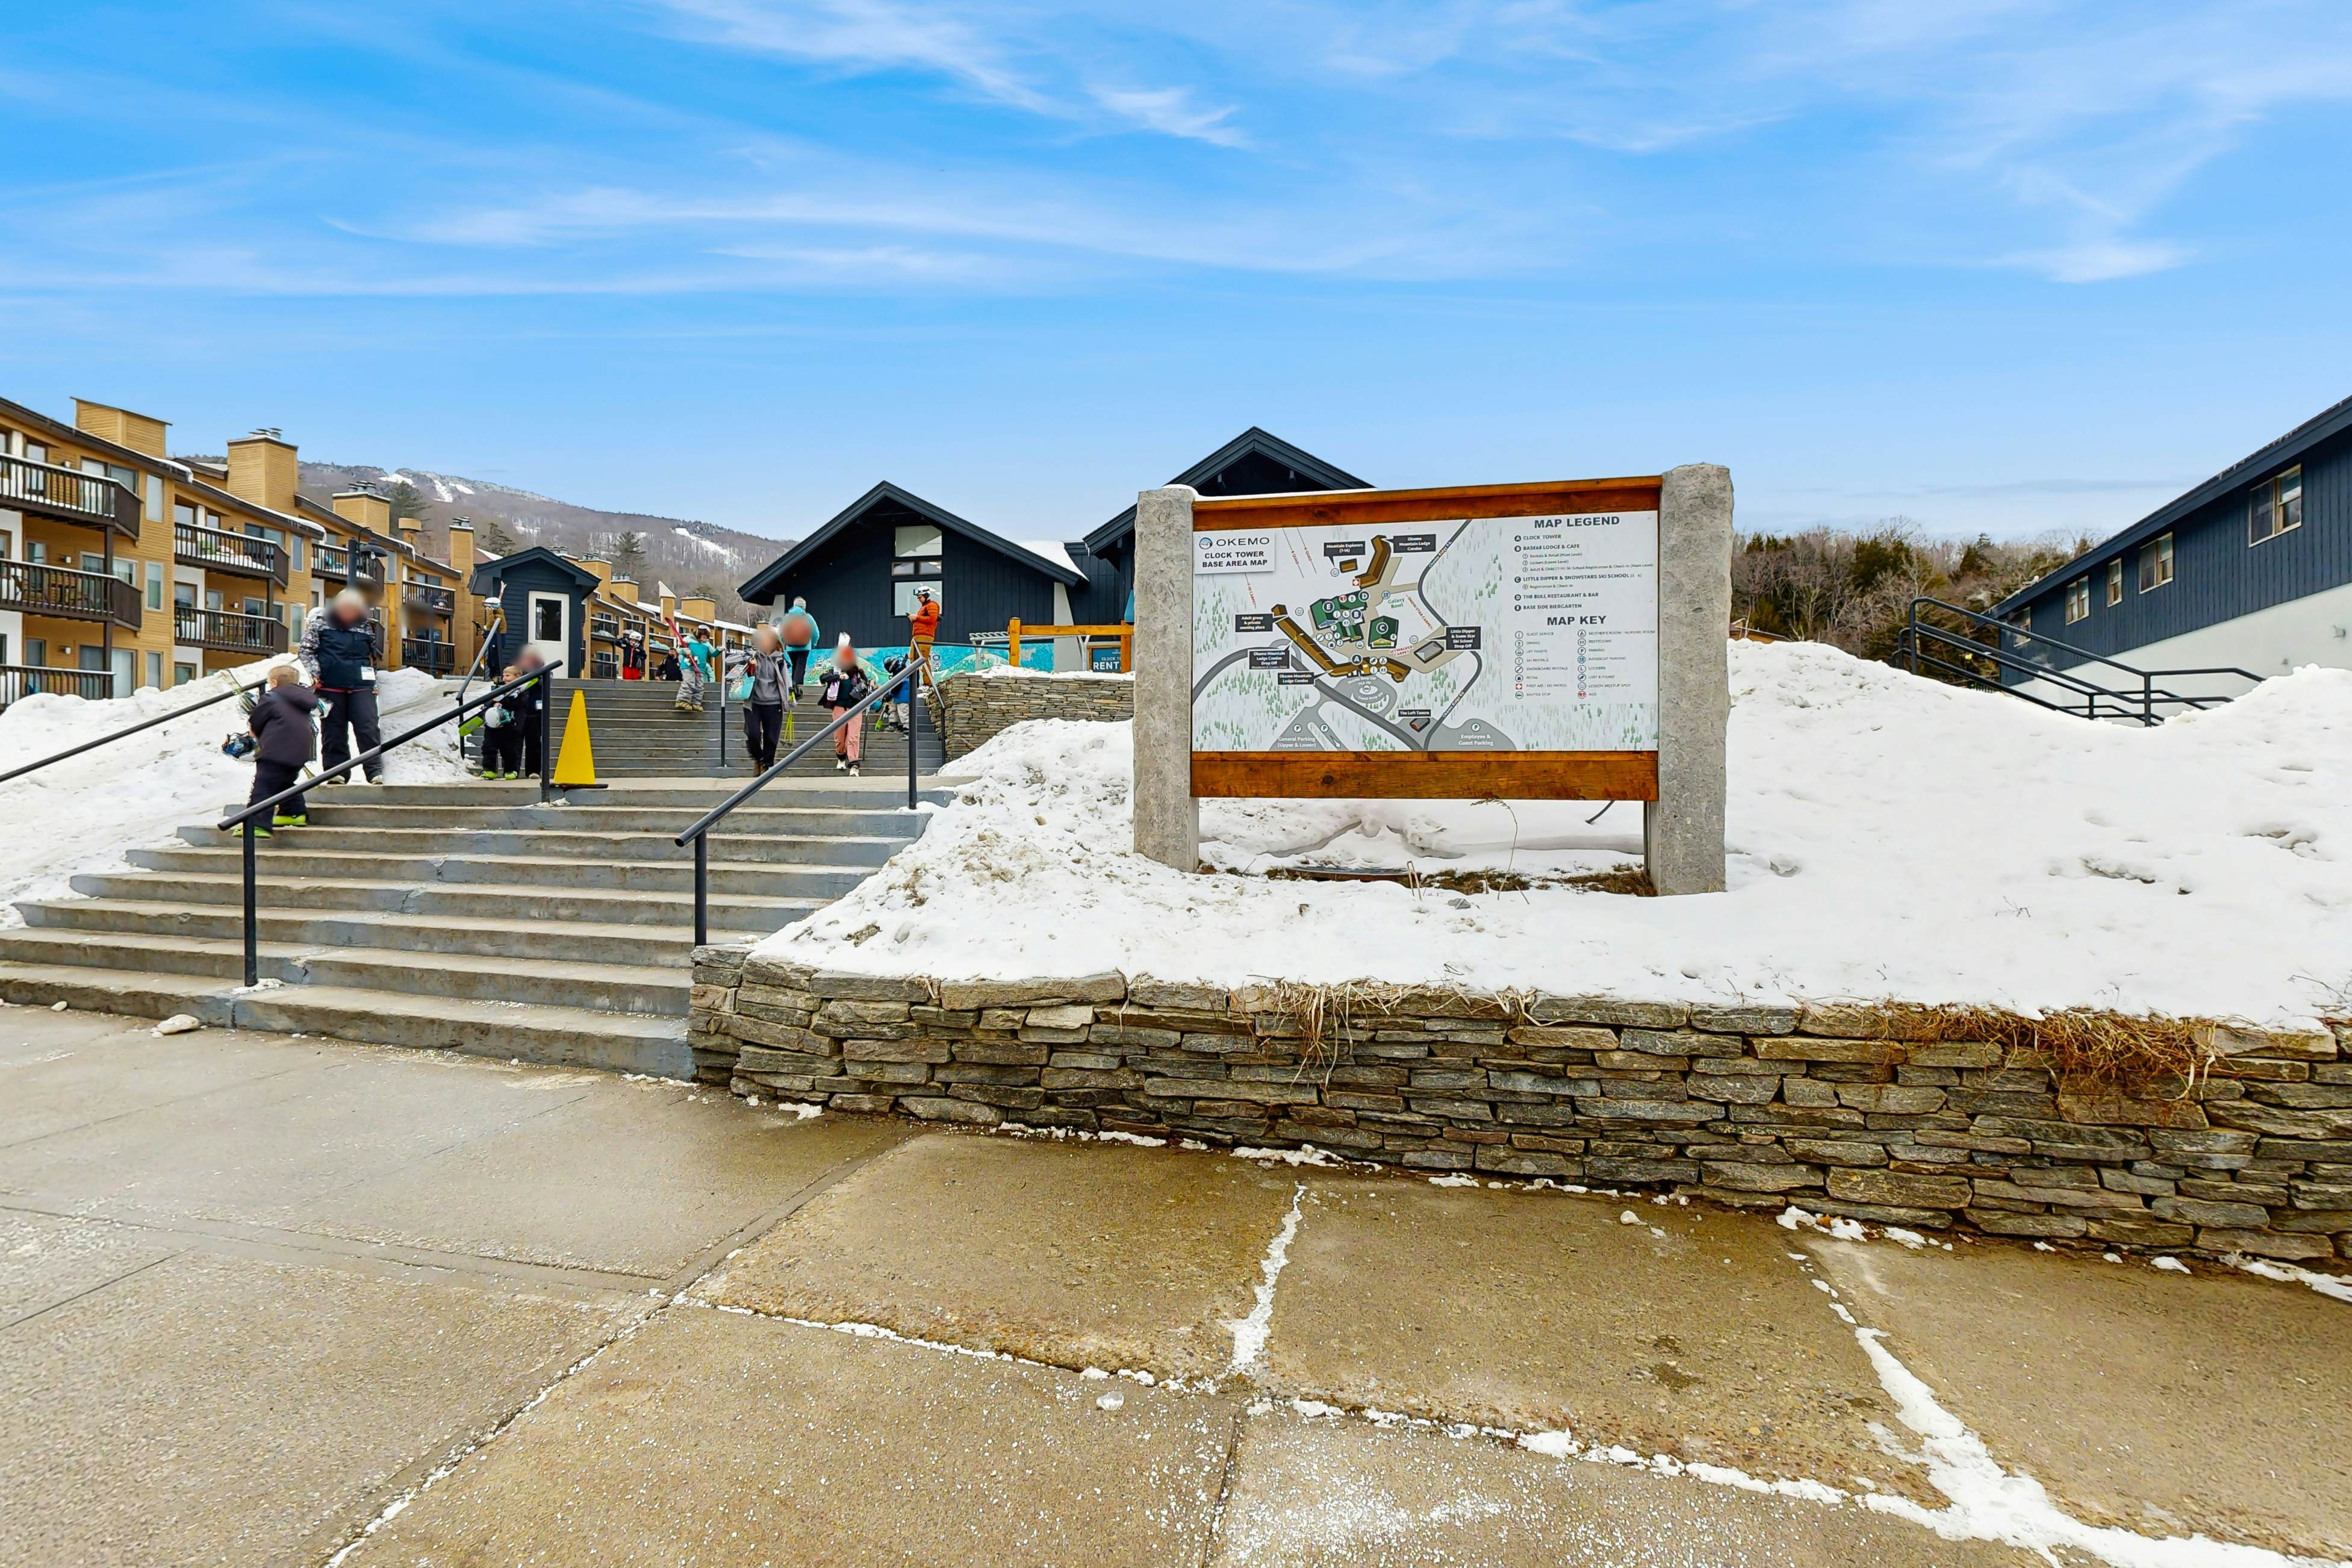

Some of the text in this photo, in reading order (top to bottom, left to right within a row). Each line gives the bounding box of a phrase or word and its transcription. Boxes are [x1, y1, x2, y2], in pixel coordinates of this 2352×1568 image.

[1534, 517, 1620, 528] MAP LEGEND
[1216, 537, 1269, 546] OKEMO
[1548, 615, 1607, 626] MAP KEY
